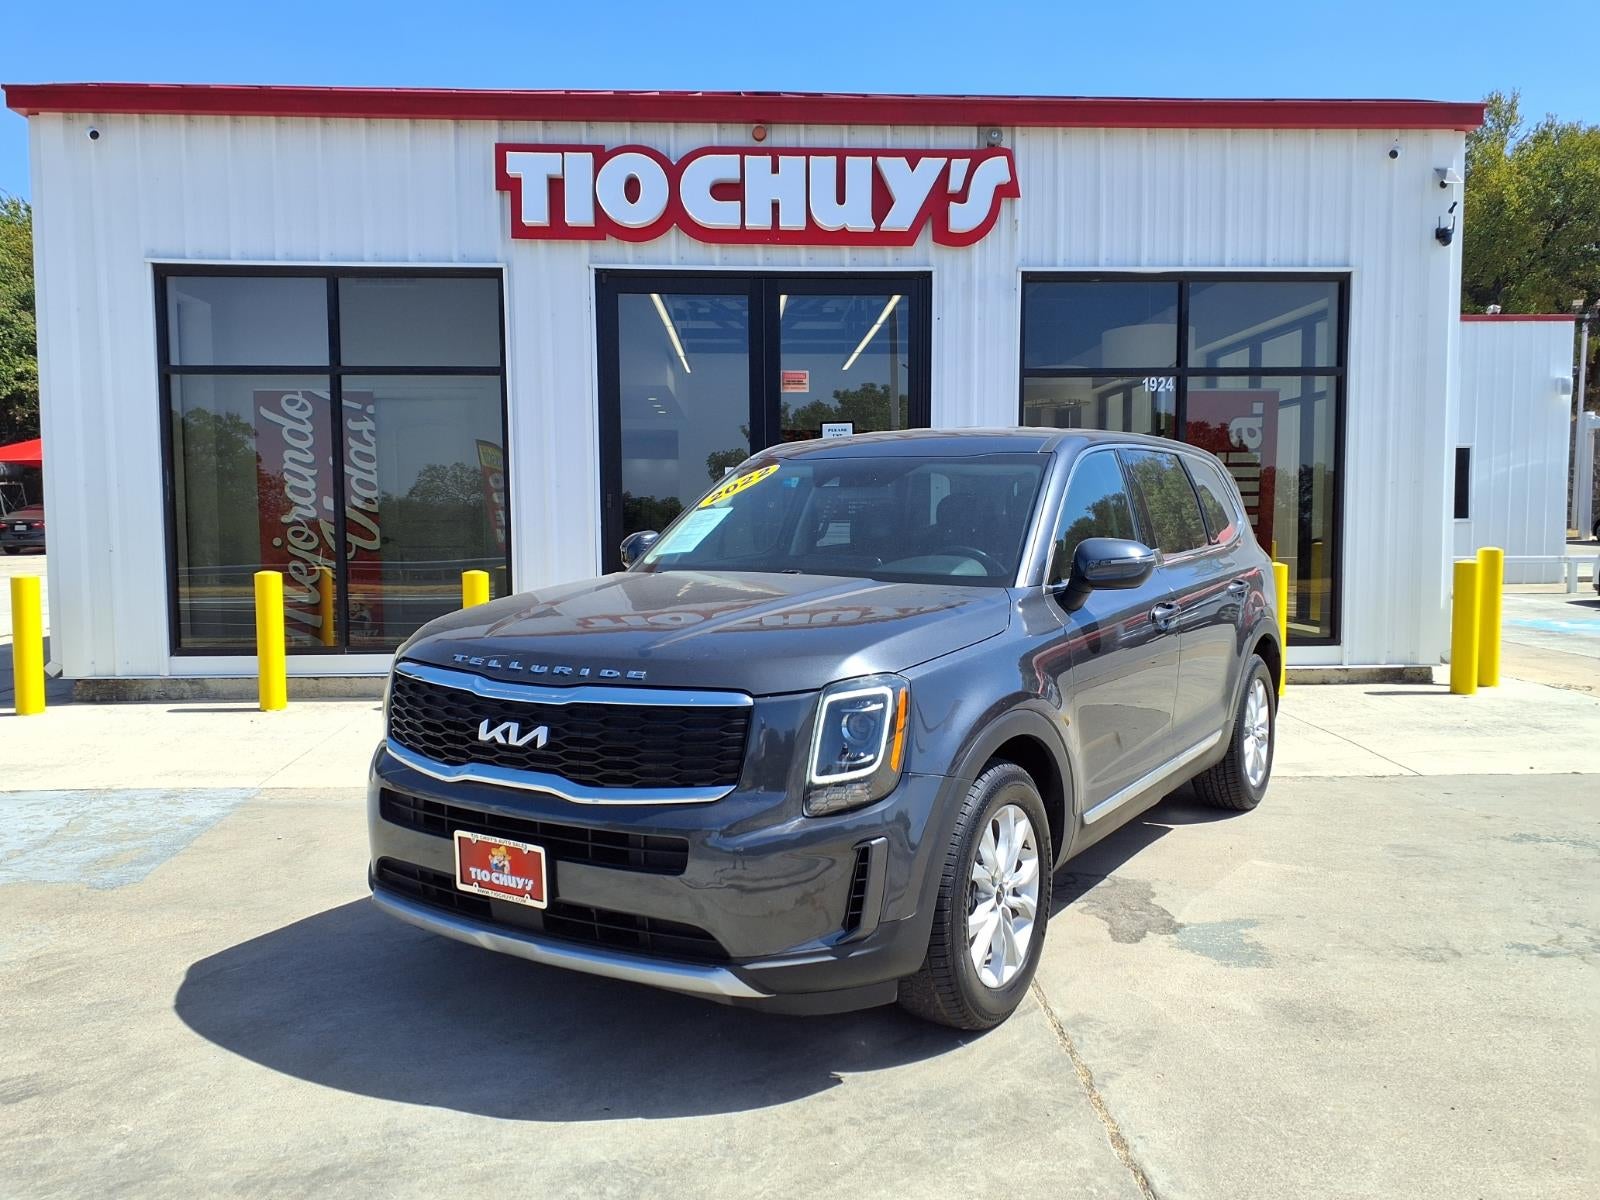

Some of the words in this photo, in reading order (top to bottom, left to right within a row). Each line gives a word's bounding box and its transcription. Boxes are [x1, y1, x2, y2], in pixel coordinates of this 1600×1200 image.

[1142, 377, 1174, 393] 1924
[708, 467, 770, 504] 2022
[453, 654, 647, 679] TELLURIDE
[477, 717, 549, 750] KIA
